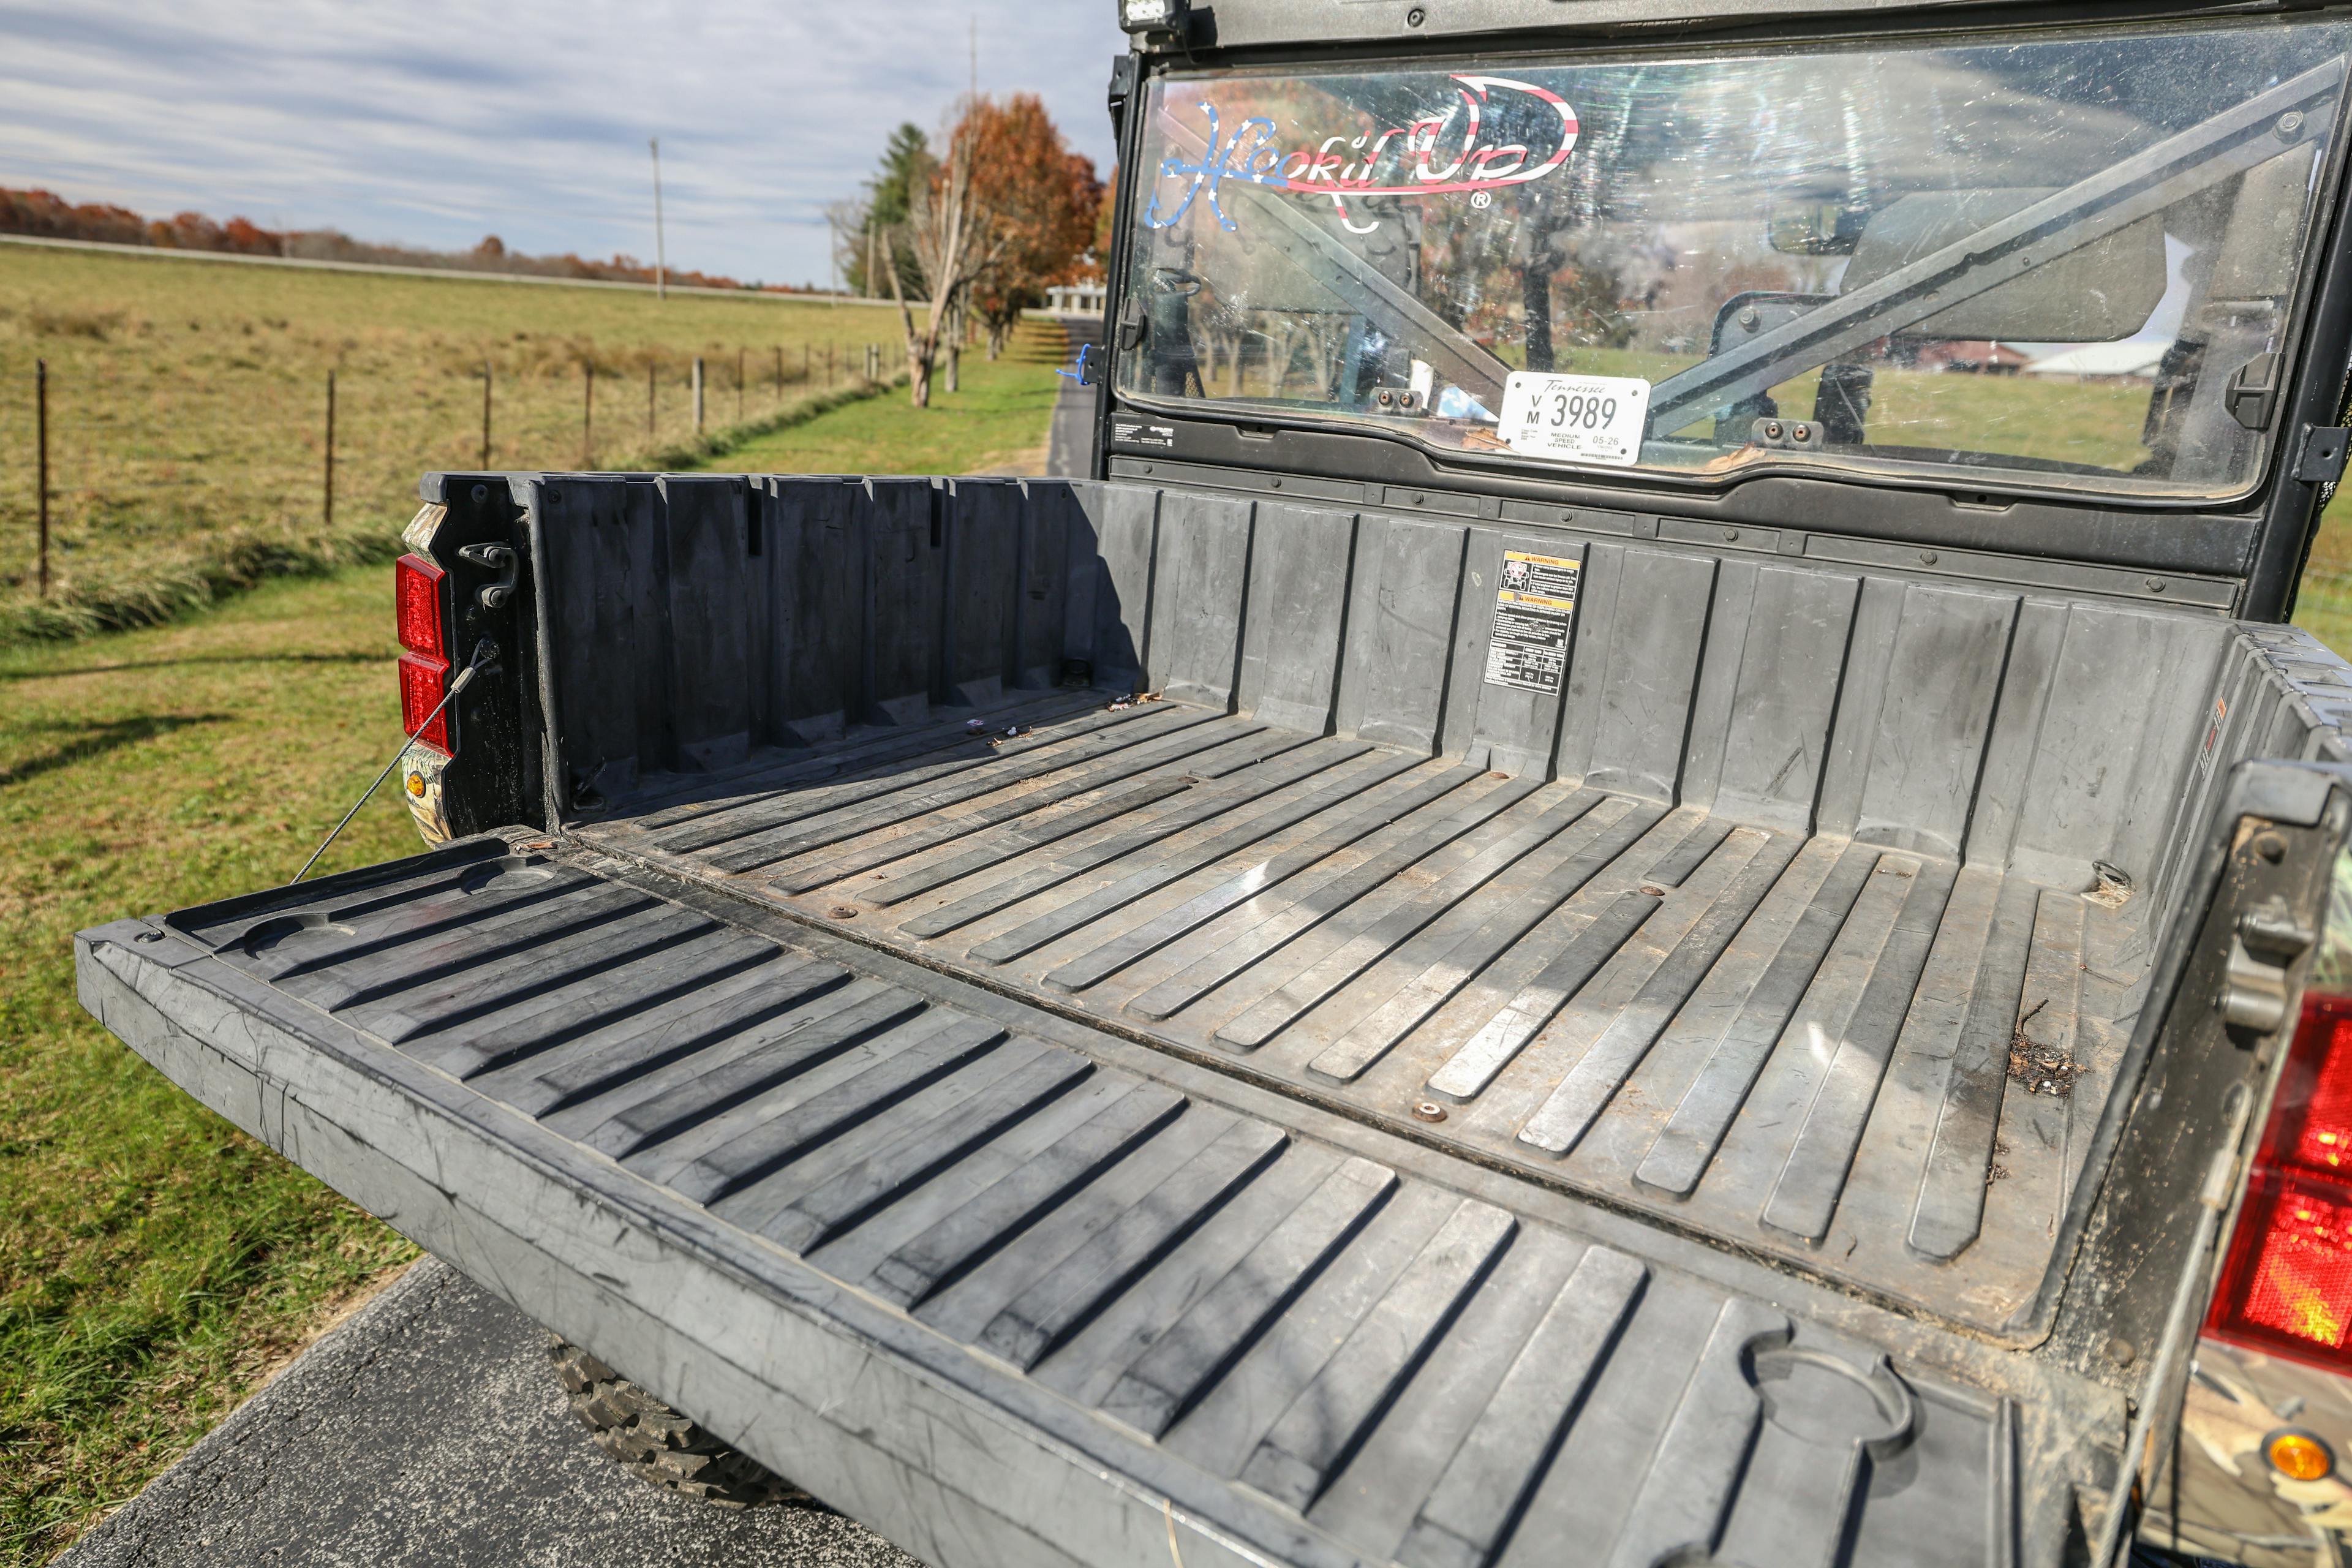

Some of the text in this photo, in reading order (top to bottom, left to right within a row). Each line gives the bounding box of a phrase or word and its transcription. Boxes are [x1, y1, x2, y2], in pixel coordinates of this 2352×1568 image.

[1408, 74, 1579, 185] Up
[1544, 380, 1605, 393] Tennessee
[1551, 394, 1618, 430] 3989
[1593, 435, 1619, 446] 05-26
[1525, 597, 1553, 605] WARNING
